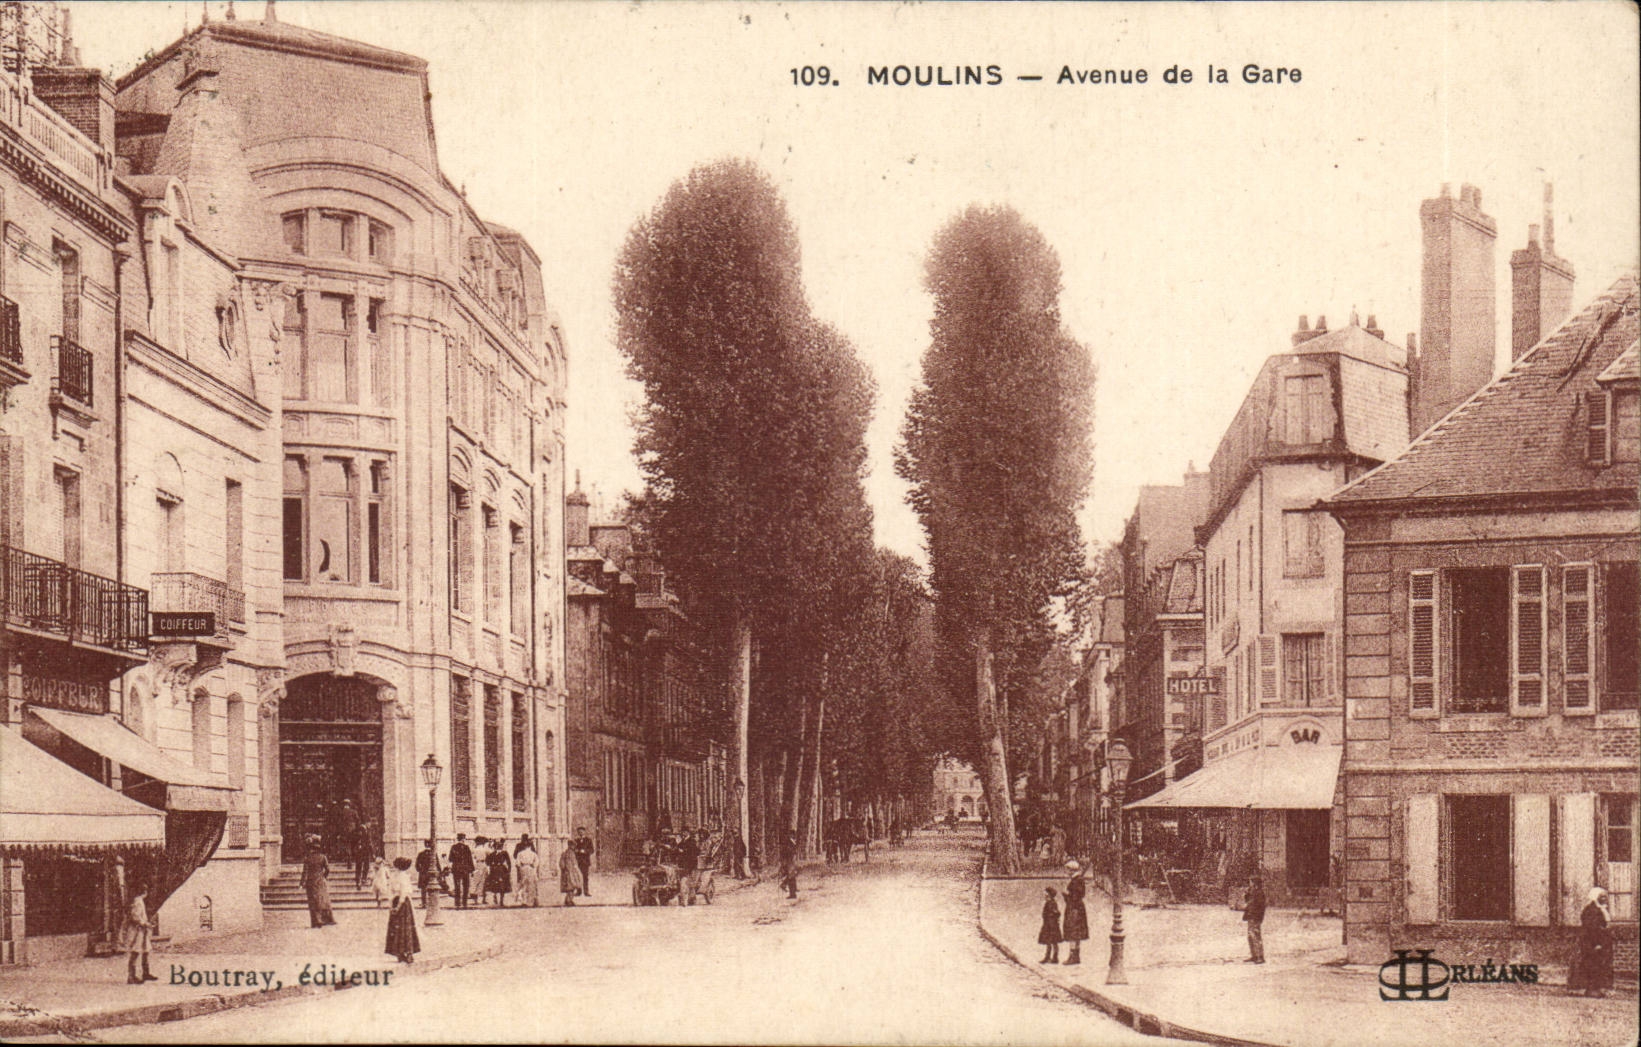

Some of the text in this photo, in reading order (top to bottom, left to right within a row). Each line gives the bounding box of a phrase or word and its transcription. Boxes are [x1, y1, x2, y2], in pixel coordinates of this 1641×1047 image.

[160, 618, 207, 630] COIFFEUR
[1169, 679, 1218, 693] HOTEL
[1290, 728, 1321, 745] BAR
